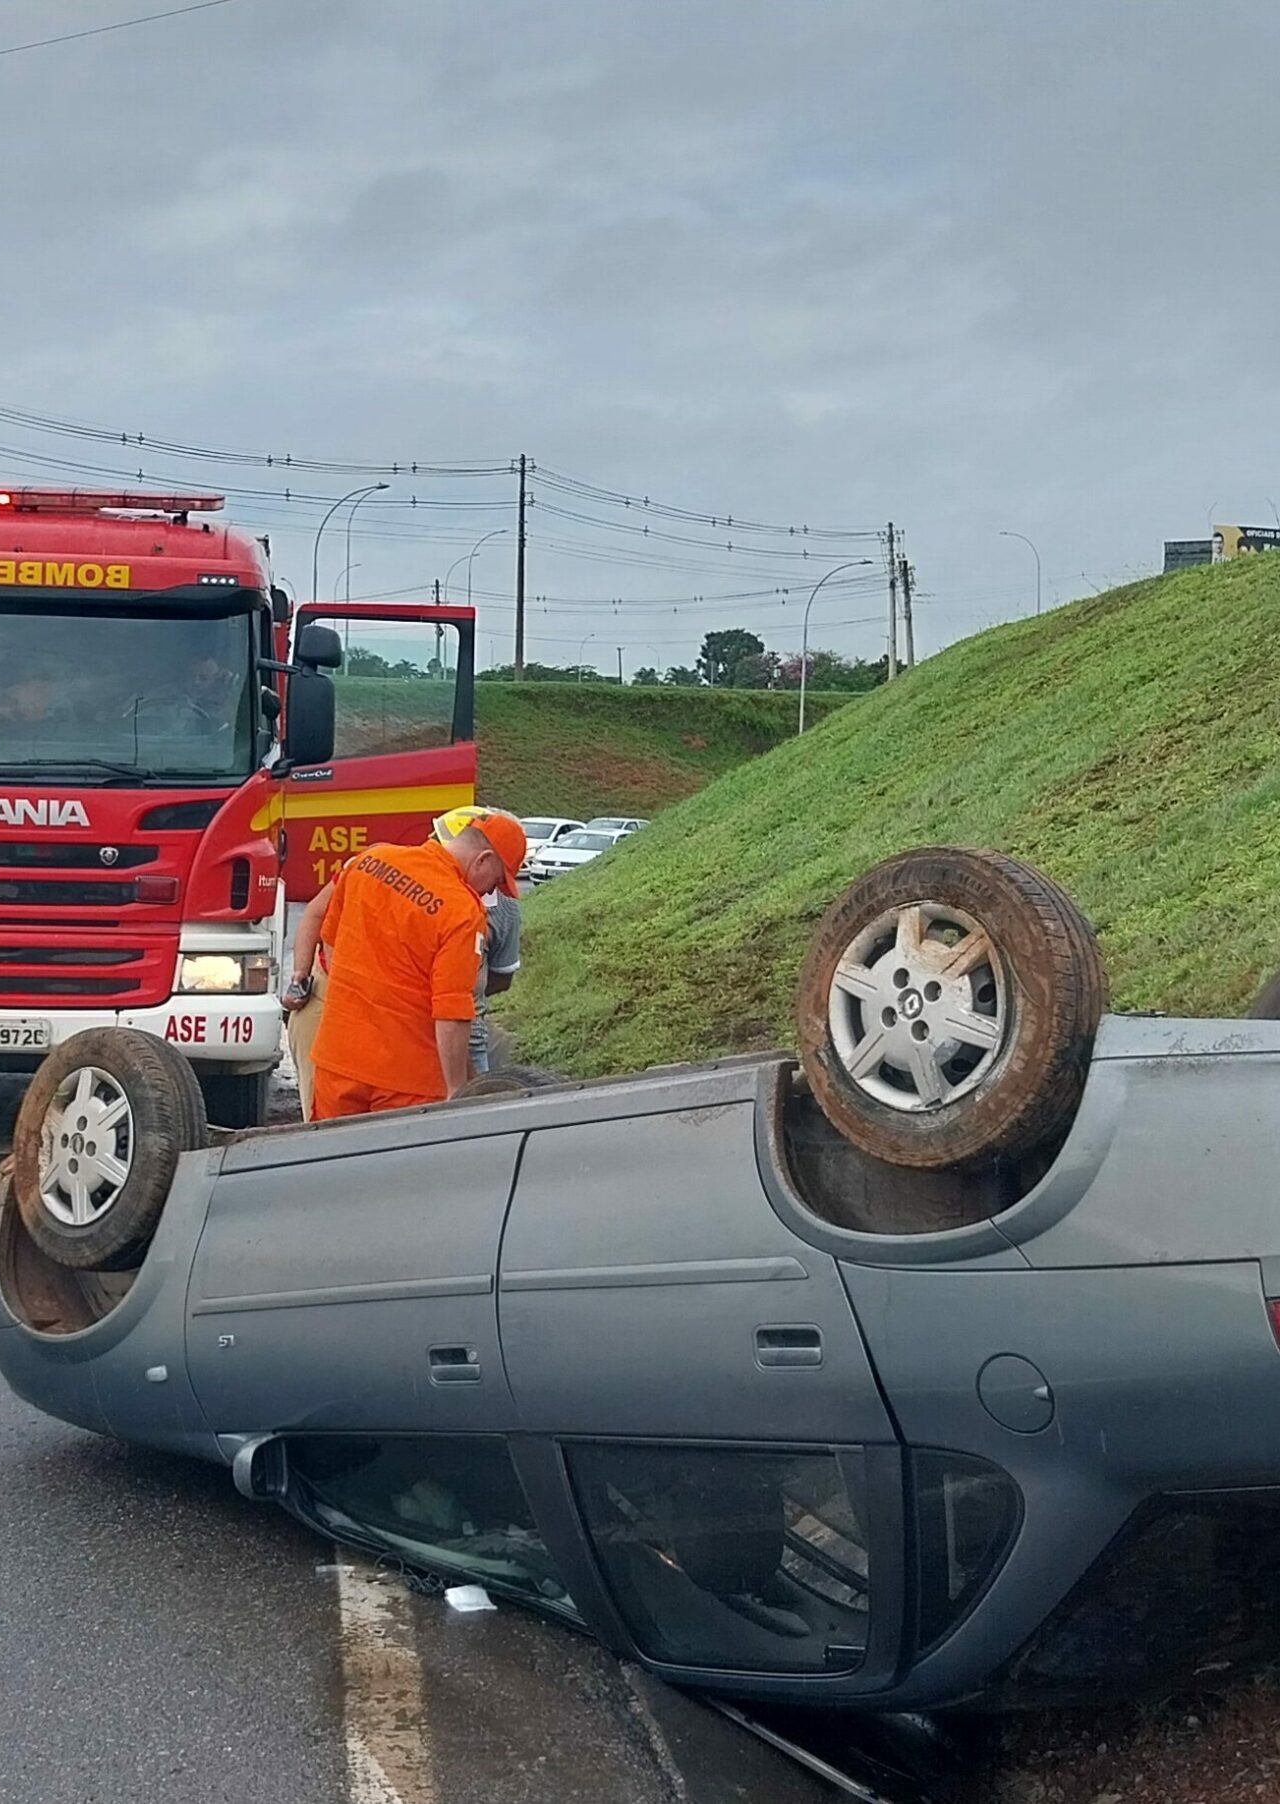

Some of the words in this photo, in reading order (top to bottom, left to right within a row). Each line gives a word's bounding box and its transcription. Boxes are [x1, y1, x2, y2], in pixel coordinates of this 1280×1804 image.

[308, 825, 368, 853] ASE
[357, 855, 444, 915] BOMBEIROS
[164, 1014, 207, 1043] ASE
[219, 1016, 253, 1043] 119
